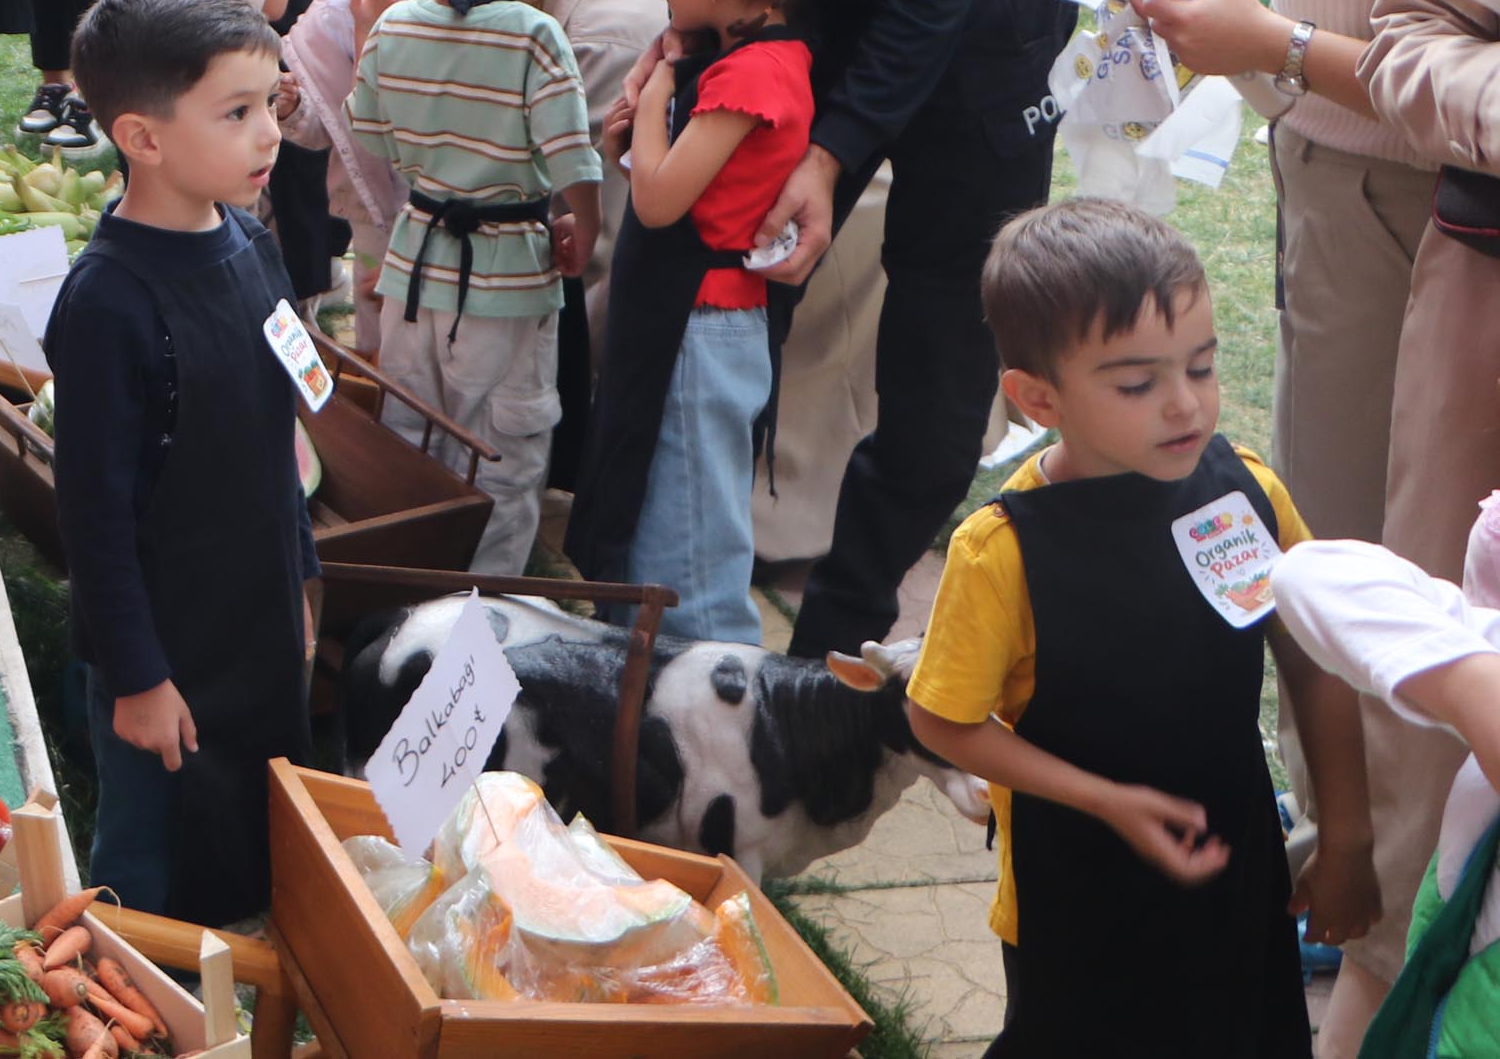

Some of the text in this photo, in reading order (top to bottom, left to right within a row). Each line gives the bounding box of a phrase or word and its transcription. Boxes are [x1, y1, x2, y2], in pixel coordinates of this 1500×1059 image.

[1022, 93, 1068, 136] PO
[1195, 529, 1259, 568] Organik
[1210, 547, 1260, 580] Pazar
